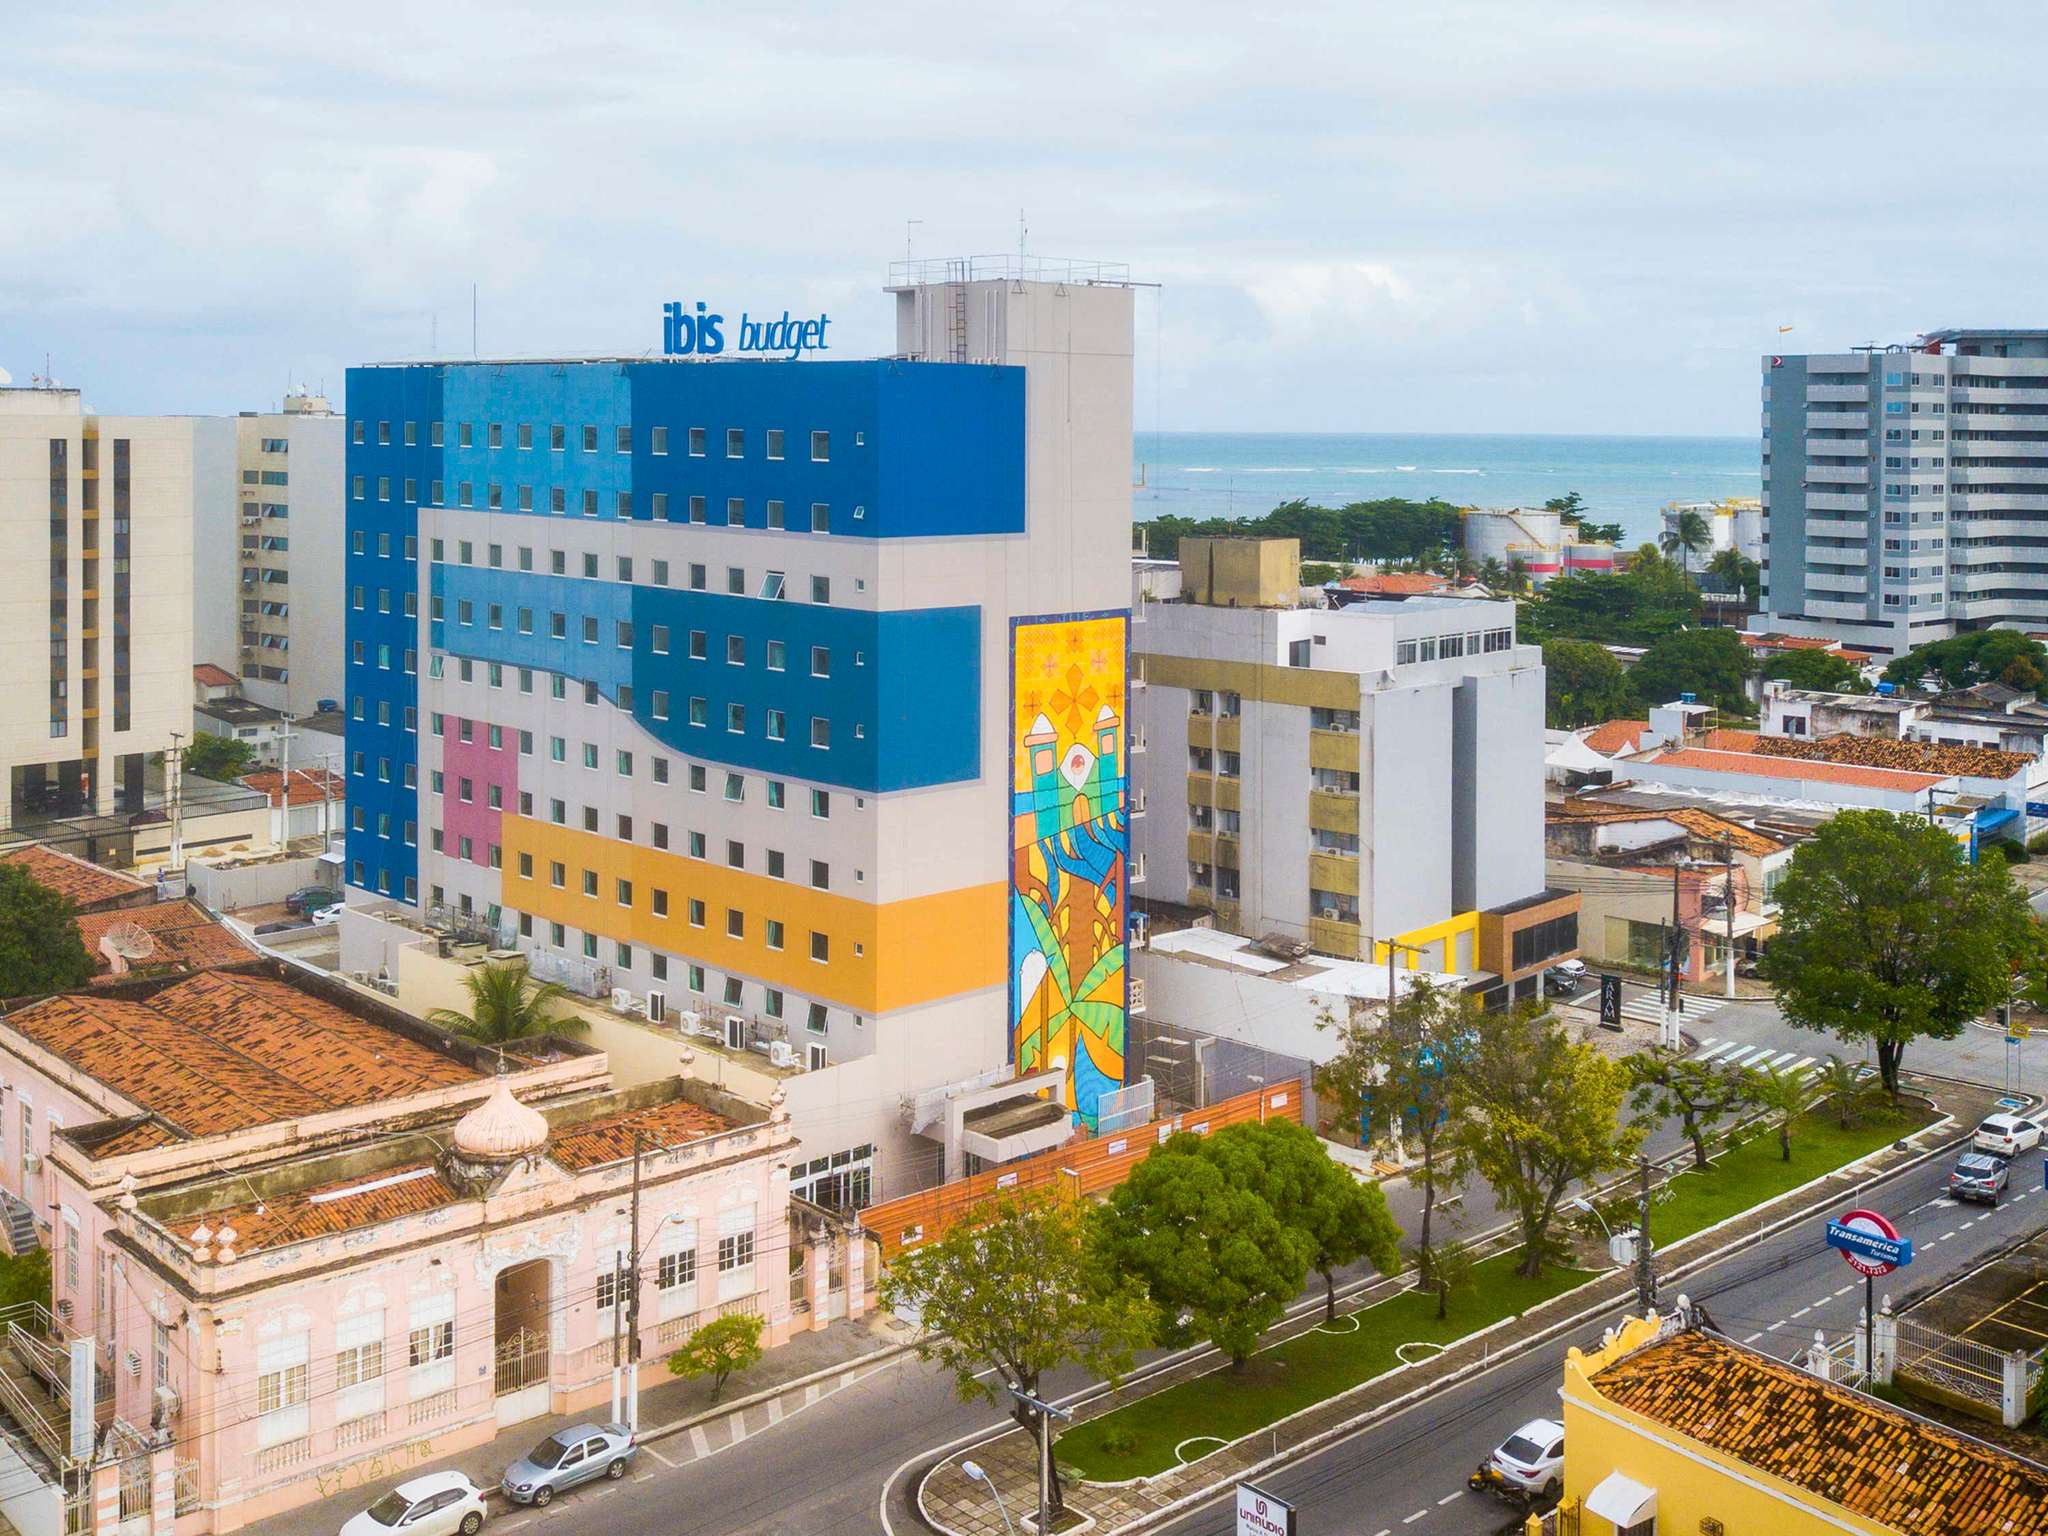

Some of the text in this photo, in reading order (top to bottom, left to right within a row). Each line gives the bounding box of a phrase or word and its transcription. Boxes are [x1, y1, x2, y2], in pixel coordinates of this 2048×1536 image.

[663, 302, 832, 360] ibis budget
[1829, 1226, 1900, 1254] Transamerica
[1870, 1248, 1898, 1262] Turismo
